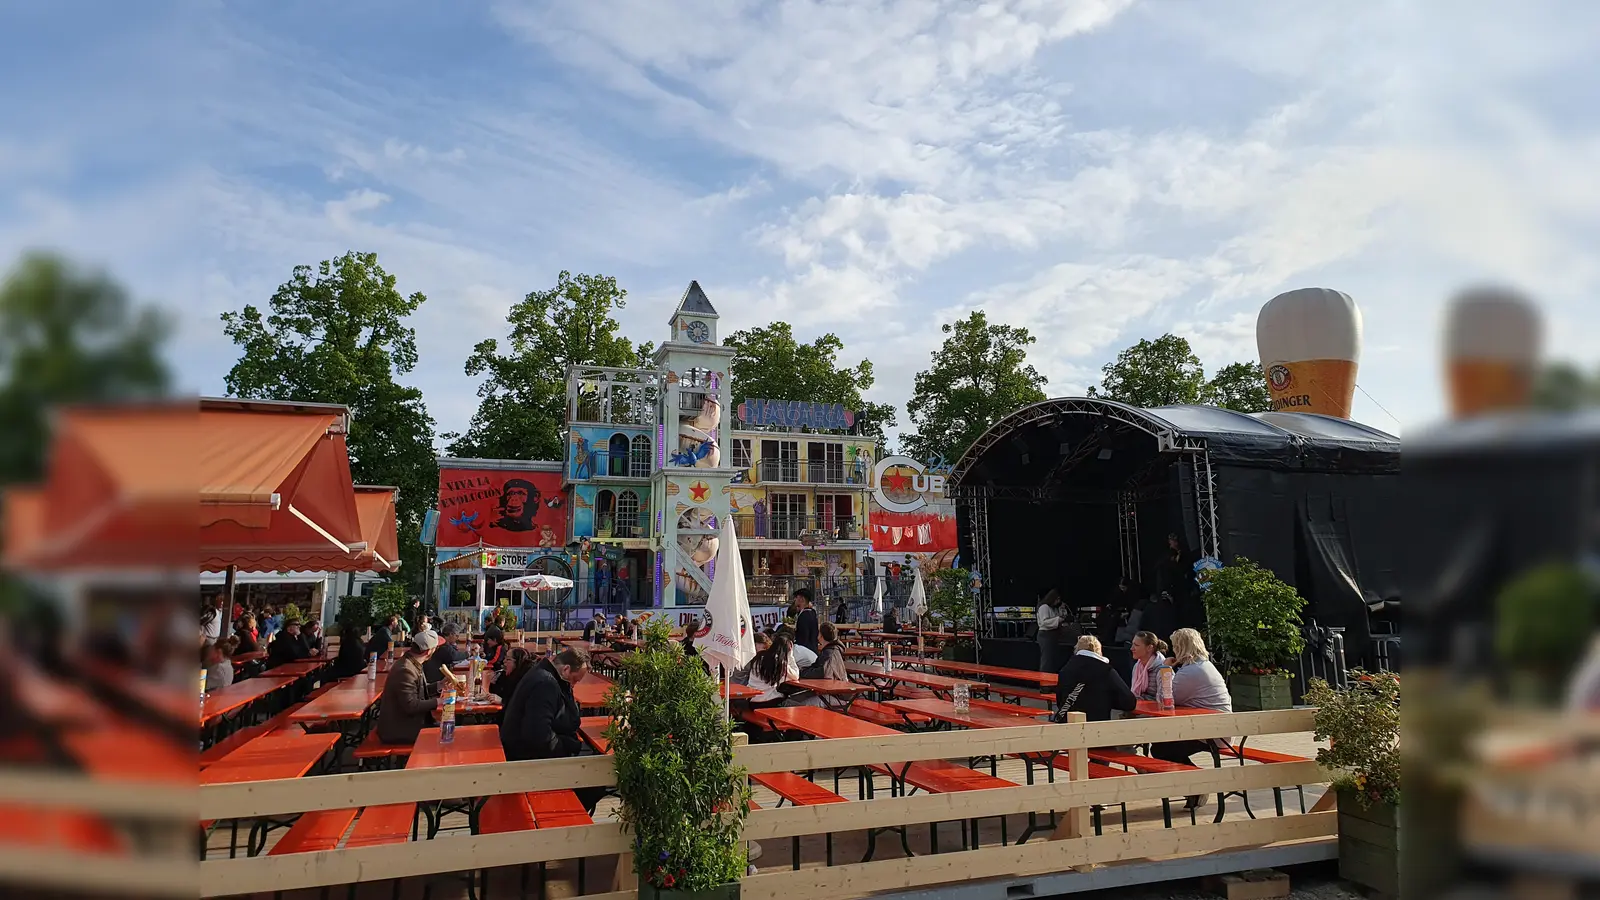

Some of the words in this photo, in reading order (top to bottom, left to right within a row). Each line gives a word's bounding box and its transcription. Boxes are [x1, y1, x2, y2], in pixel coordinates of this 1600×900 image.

[745, 399, 851, 429] HAVANA
[447, 478, 474, 491] VIVA
[476, 476, 490, 487] LA
[873, 454, 945, 513] CUB
[501, 554, 527, 565] STORE
